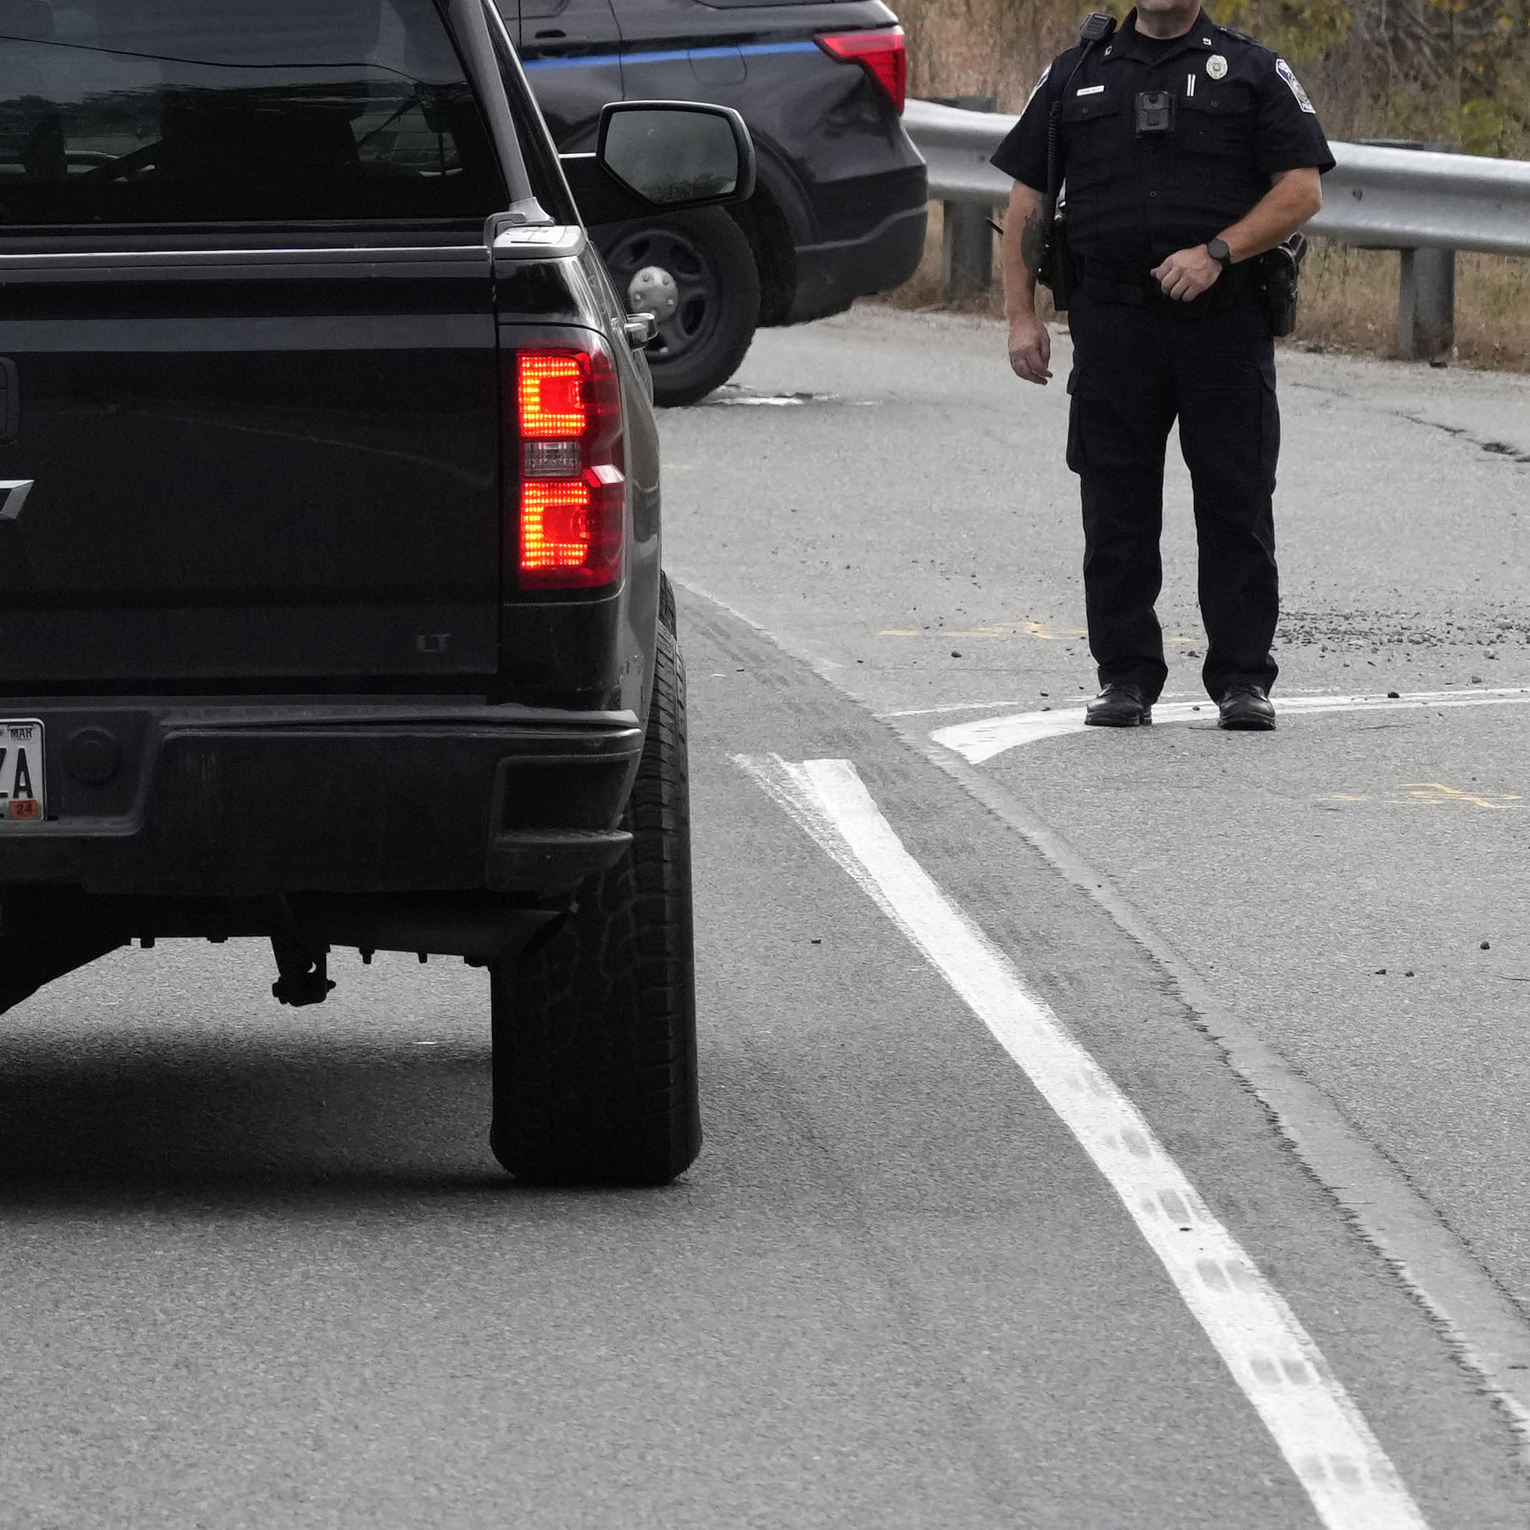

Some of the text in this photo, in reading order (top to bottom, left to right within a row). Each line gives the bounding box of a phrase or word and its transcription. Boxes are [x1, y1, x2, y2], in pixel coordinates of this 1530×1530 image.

[416, 633, 452, 653] LT
[10, 728, 33, 740] MAR
[16, 802, 32, 815] 24
